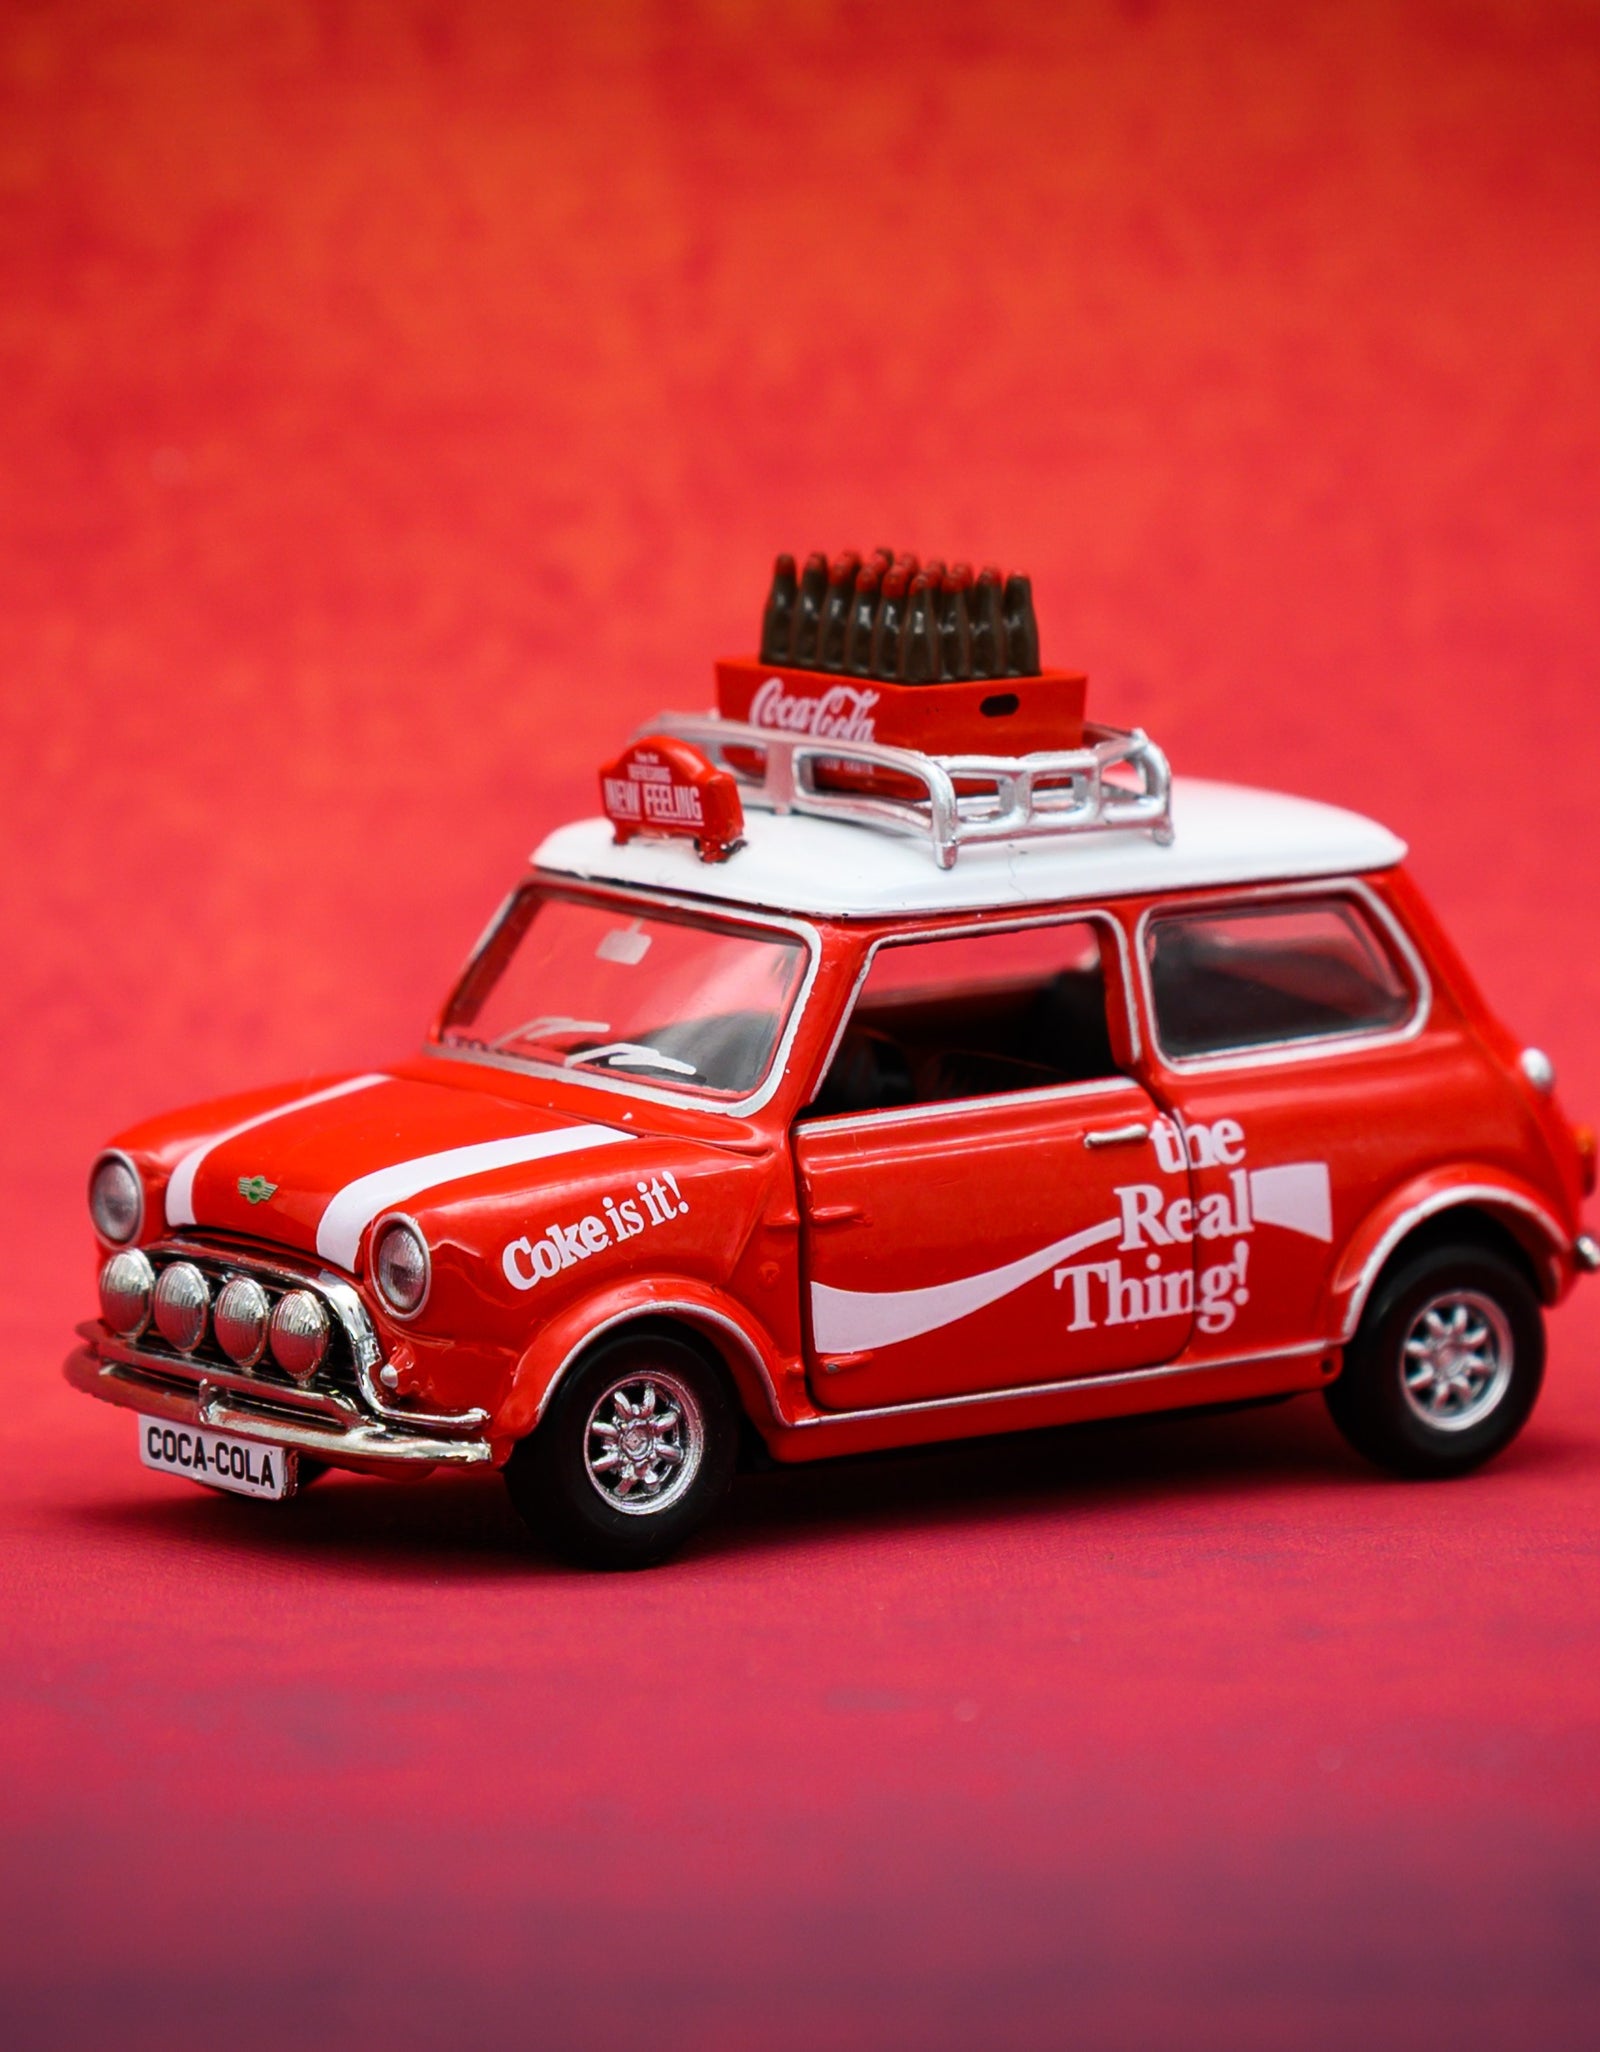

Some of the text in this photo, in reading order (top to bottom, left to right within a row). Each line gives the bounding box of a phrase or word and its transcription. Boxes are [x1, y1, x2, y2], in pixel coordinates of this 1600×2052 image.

[642, 783, 704, 821] FEELING
[1150, 1109, 1246, 1174] the
[502, 1171, 689, 1290] Coke is it!
[1113, 1168, 1254, 1251] Real
[1054, 1240, 1249, 1334] Thing!
[147, 1426, 275, 1489] COCA-COLA
